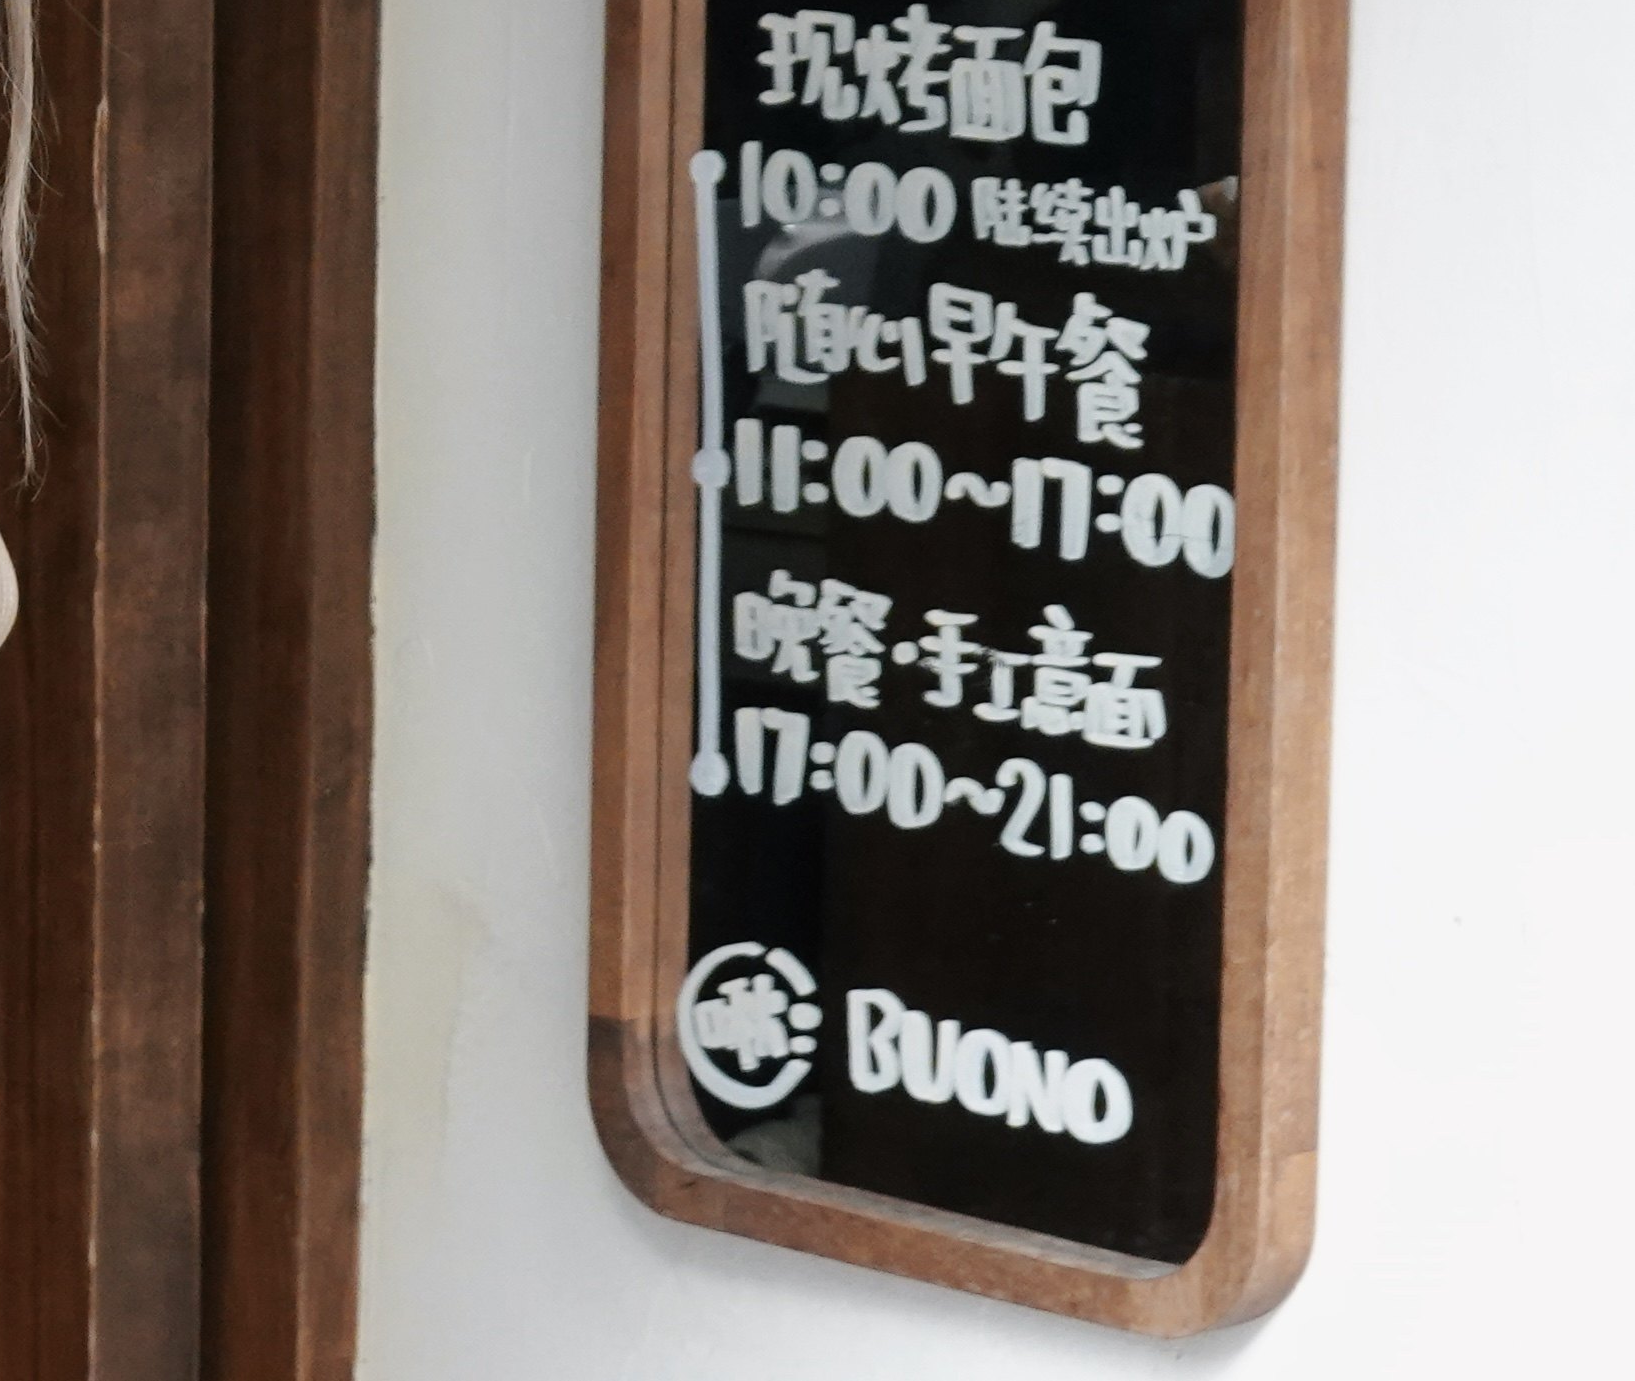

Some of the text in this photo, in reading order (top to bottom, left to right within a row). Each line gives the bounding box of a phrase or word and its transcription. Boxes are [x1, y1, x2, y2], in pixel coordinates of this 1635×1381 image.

[757, 4, 1102, 146] 现烤面包
[740, 140, 1216, 270] 10:00 陆续出炉
[743, 268, 1151, 450] 随心早午餐
[735, 418, 1236, 579] 11:00~17:00
[734, 706, 1215, 885] 17:00~21:00
[846, 988, 1133, 1144] BUONO
